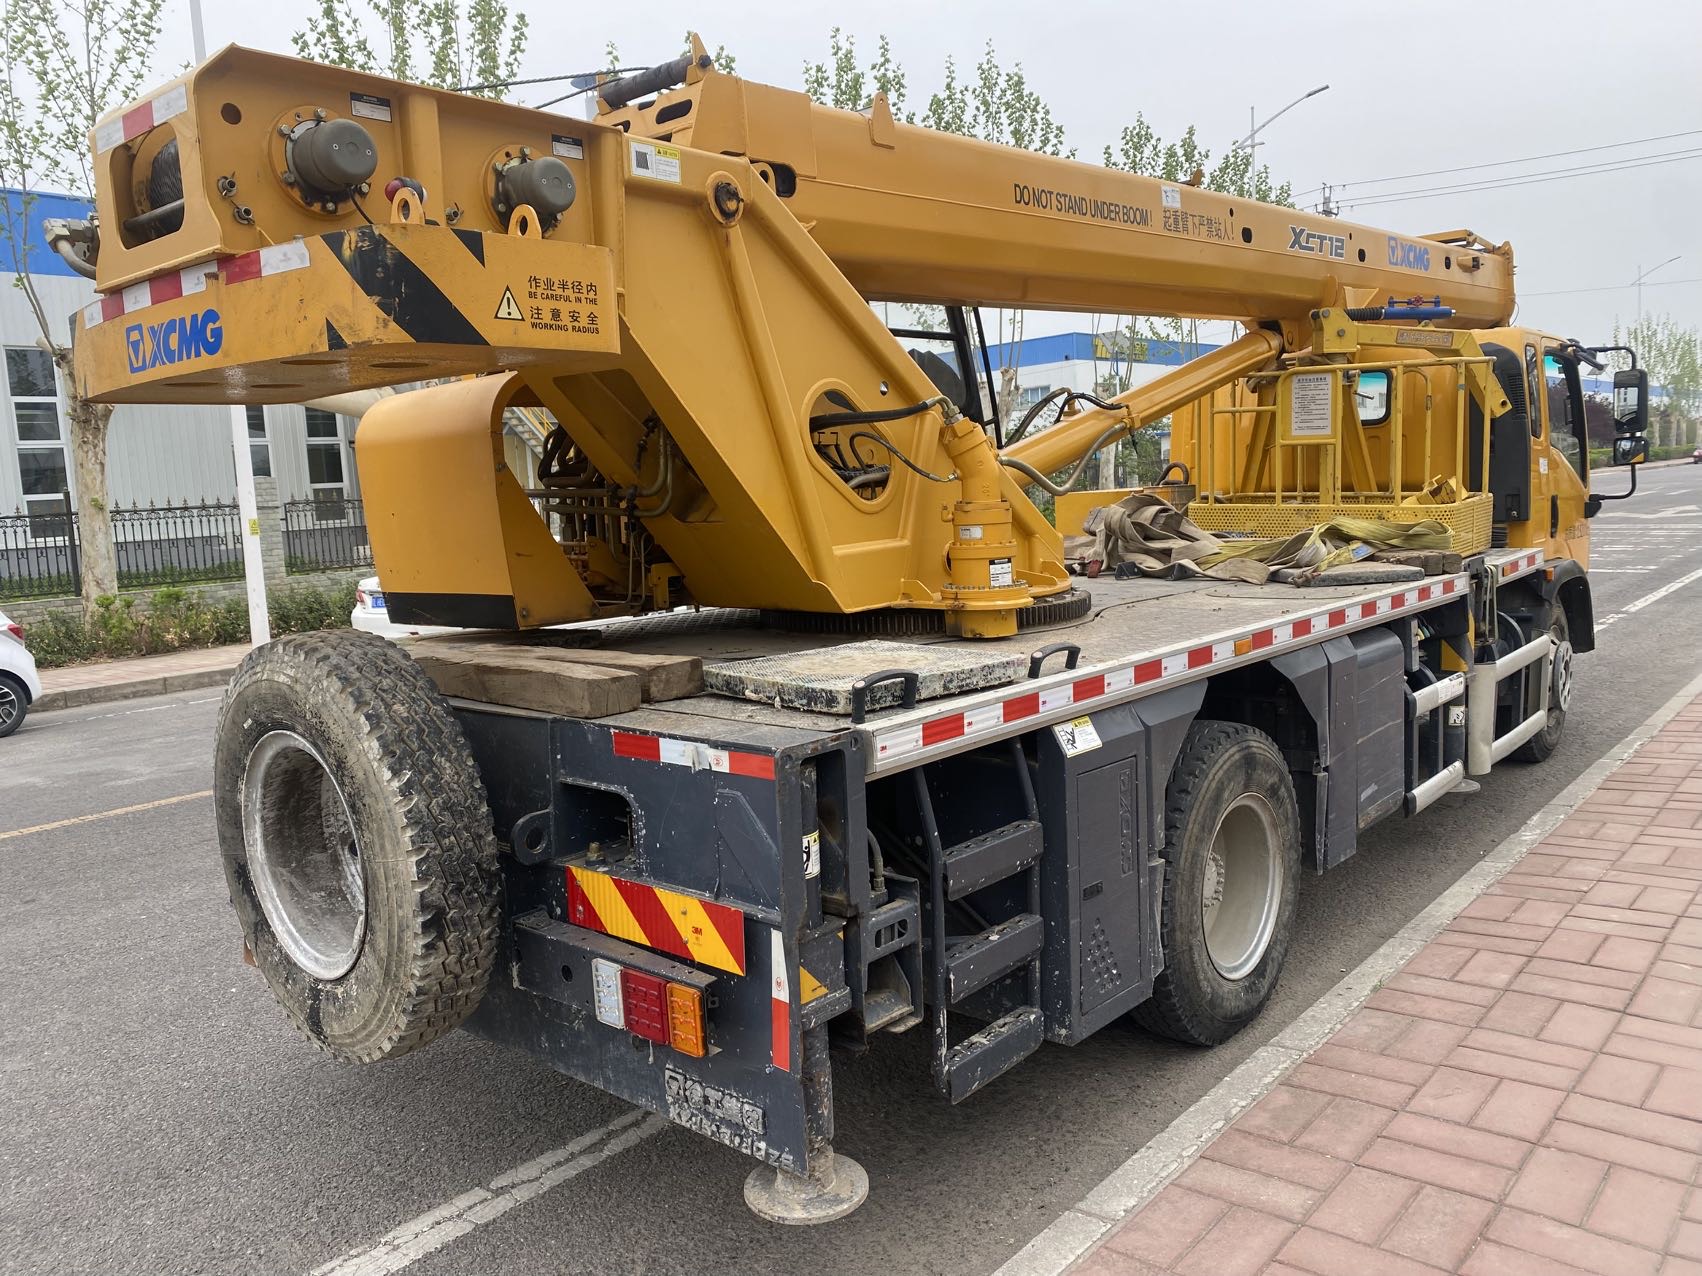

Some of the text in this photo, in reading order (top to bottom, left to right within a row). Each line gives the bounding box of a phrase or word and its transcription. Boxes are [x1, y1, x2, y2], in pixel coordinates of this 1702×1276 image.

[1014, 183, 1030, 205] DO
[1032, 187, 1053, 209] NOT
[1056, 192, 1088, 216] STAND
[1089, 198, 1121, 221] UNDER
[1288, 225, 1346, 260] XCT12
[1398, 241, 1430, 272] XCMG
[528, 275, 598, 296] 作业半径内
[528, 290, 598, 306] BE CAREFUL IN THE
[530, 305, 599, 326] 注意安全
[530, 321, 600, 334] WORKING RADIUS
[147, 308, 223, 370] XCMG
[691, 926, 703, 936] 3M
